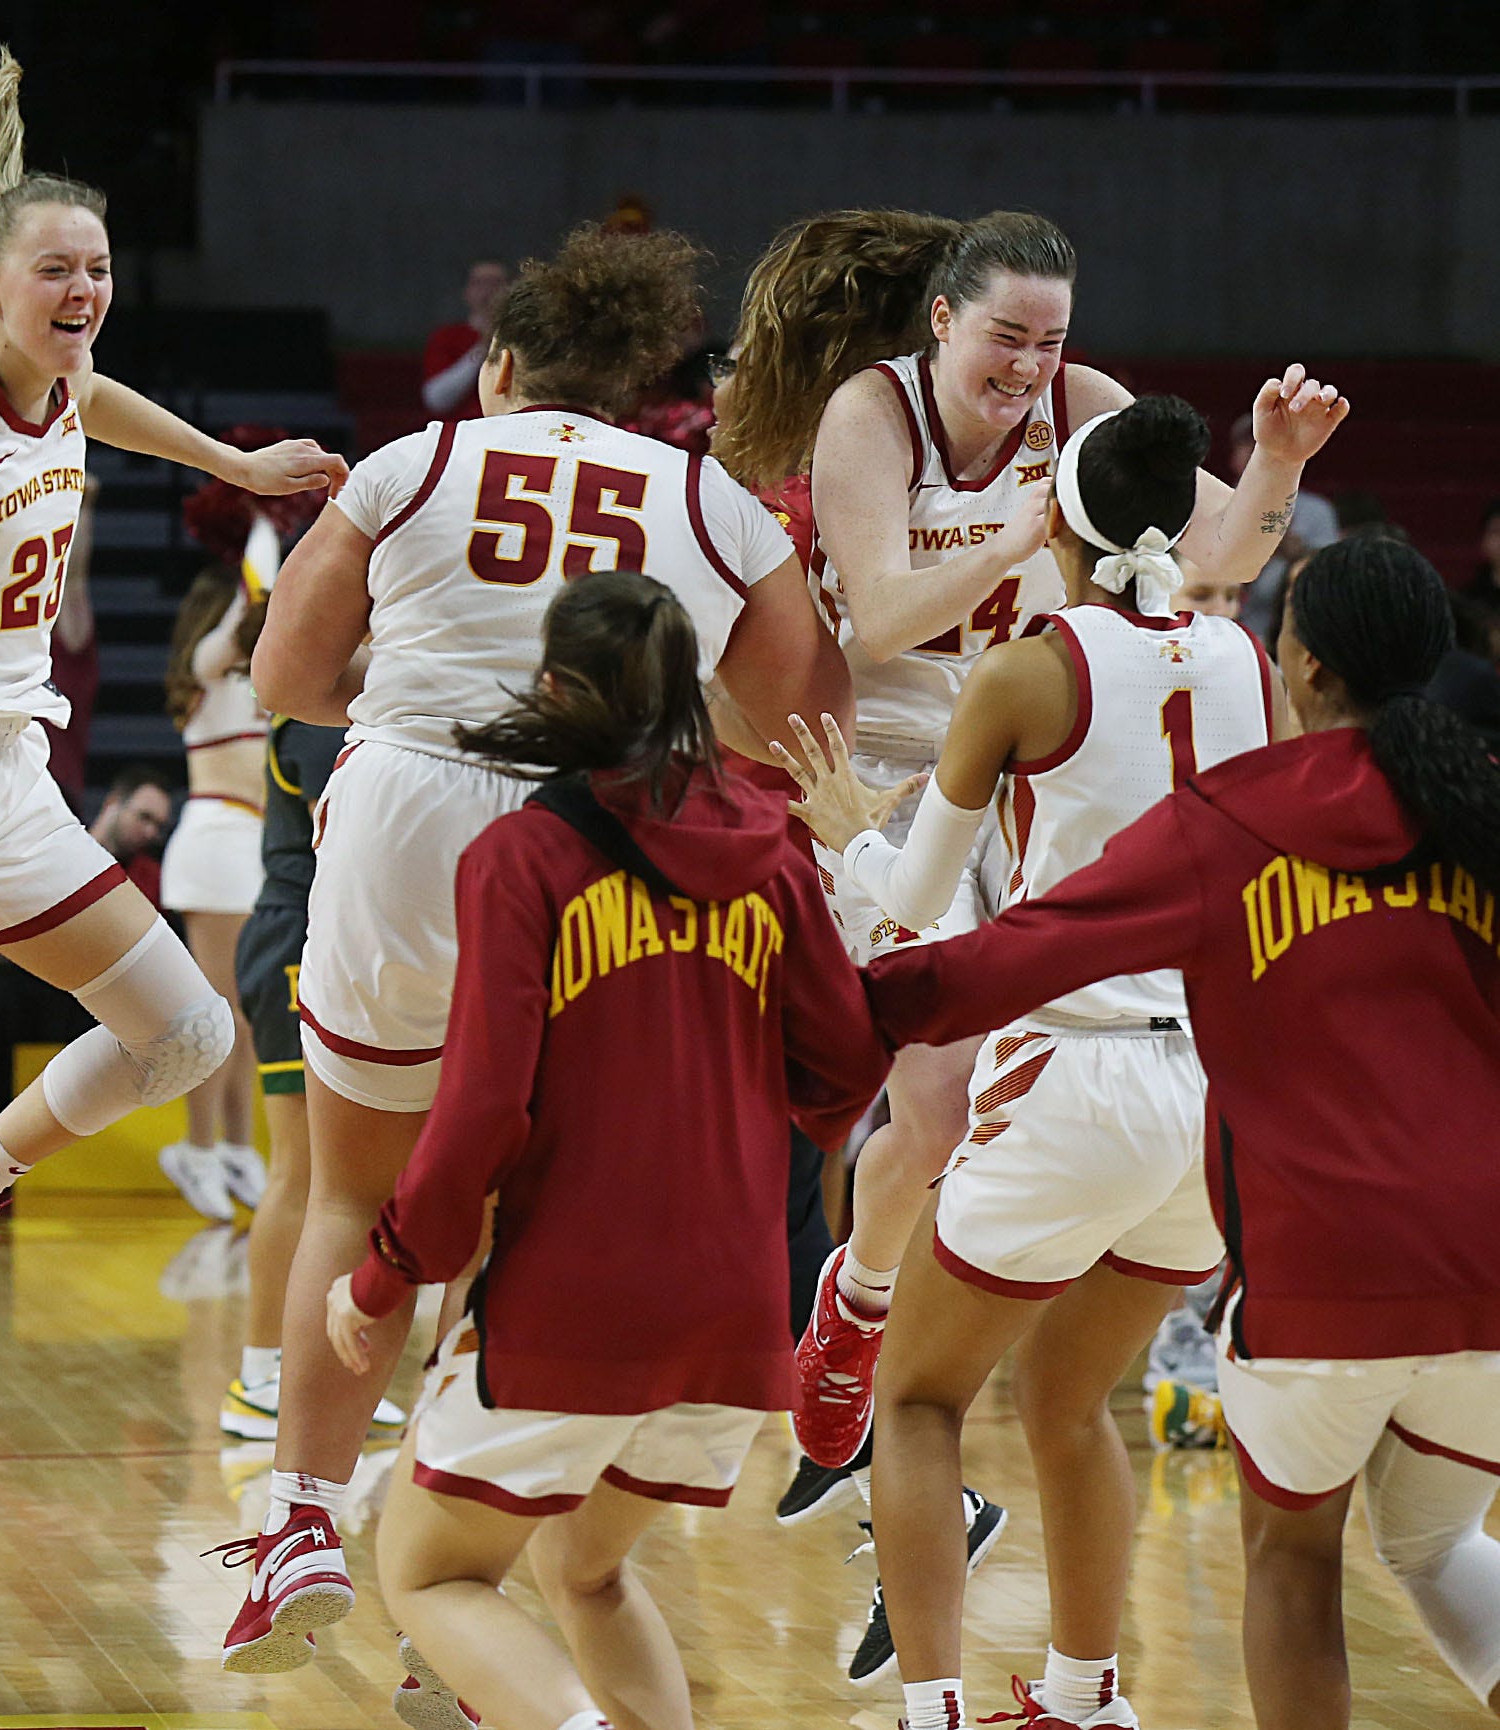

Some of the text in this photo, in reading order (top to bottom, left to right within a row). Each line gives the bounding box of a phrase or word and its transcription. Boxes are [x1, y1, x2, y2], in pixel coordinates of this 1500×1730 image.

[1028, 427, 1051, 444] 50
[468, 449, 651, 588] 55
[1159, 687, 1198, 796] 1
[548, 869, 665, 1020] IOWA
[1242, 855, 1373, 983] IOWA
